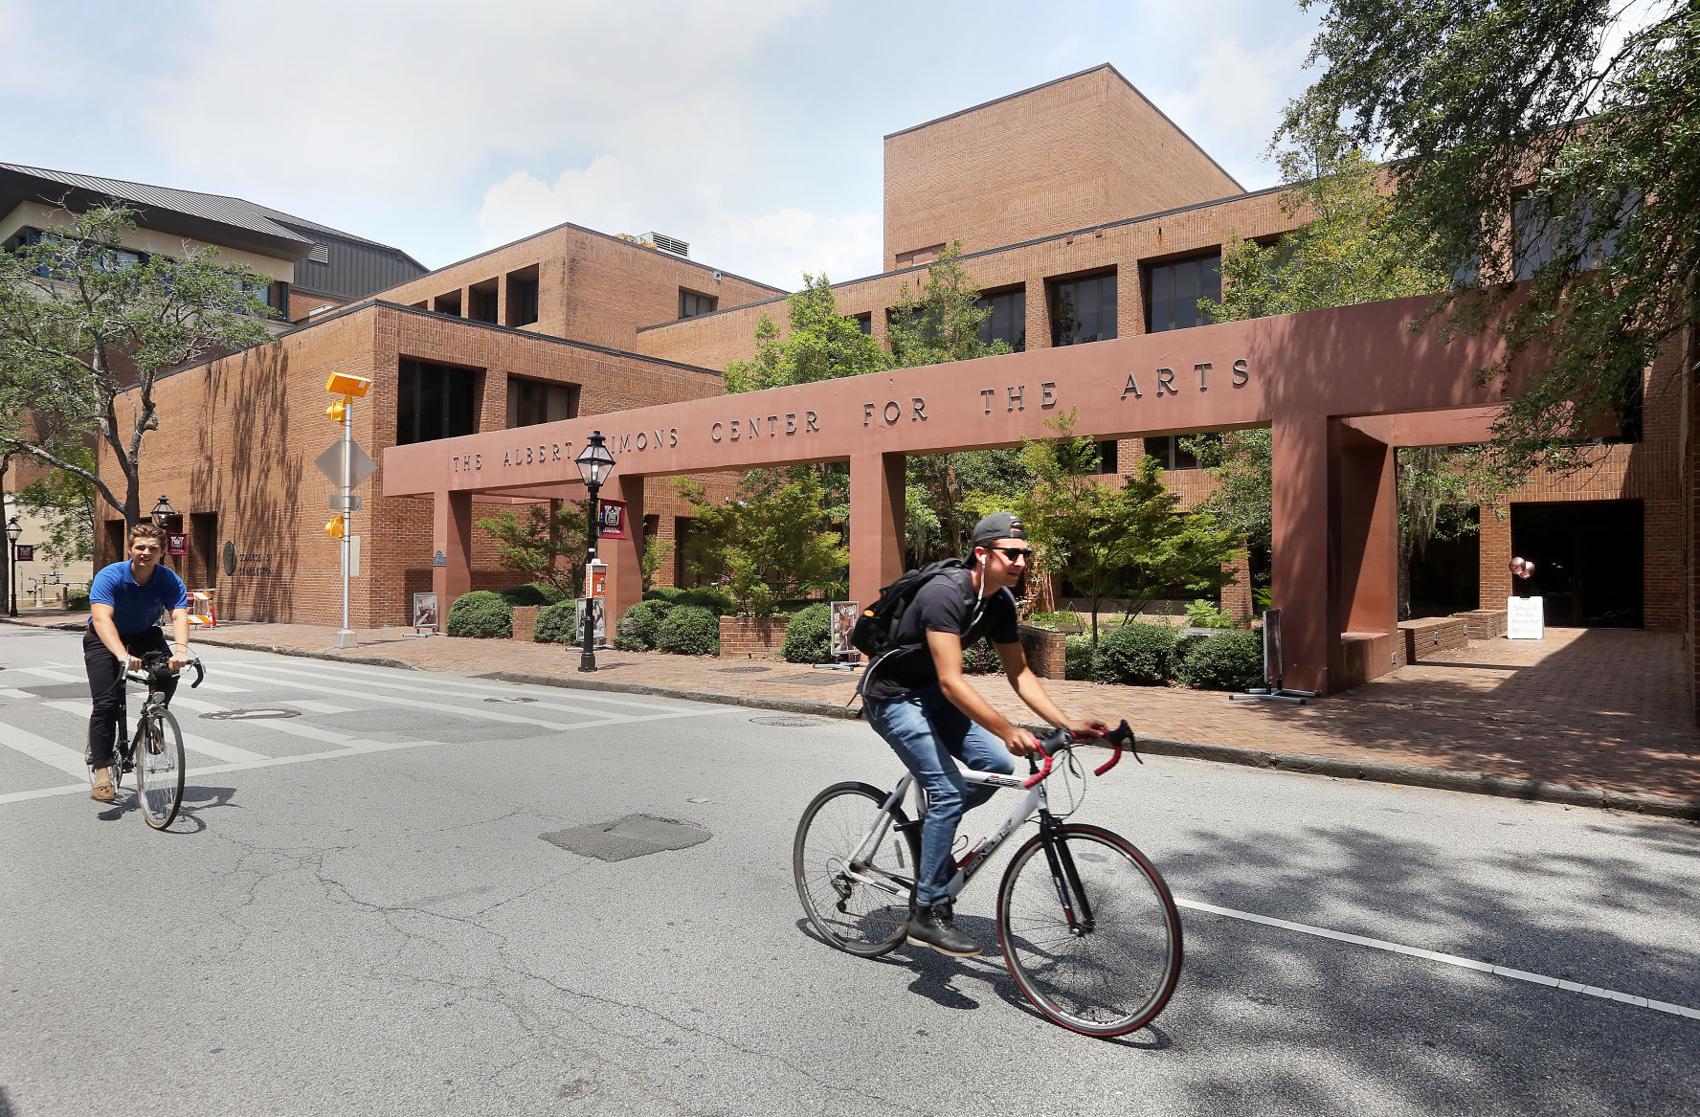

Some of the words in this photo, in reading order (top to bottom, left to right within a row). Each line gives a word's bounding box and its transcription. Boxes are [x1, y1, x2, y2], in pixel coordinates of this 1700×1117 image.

[453, 454, 483, 473] THE
[503, 441, 573, 467] ALBERT
[608, 428, 679, 454] IMONS
[711, 410, 820, 443] CENTER
[863, 396, 928, 428] FOR
[980, 381, 1058, 415] THE
[1120, 358, 1249, 401] ARTS
